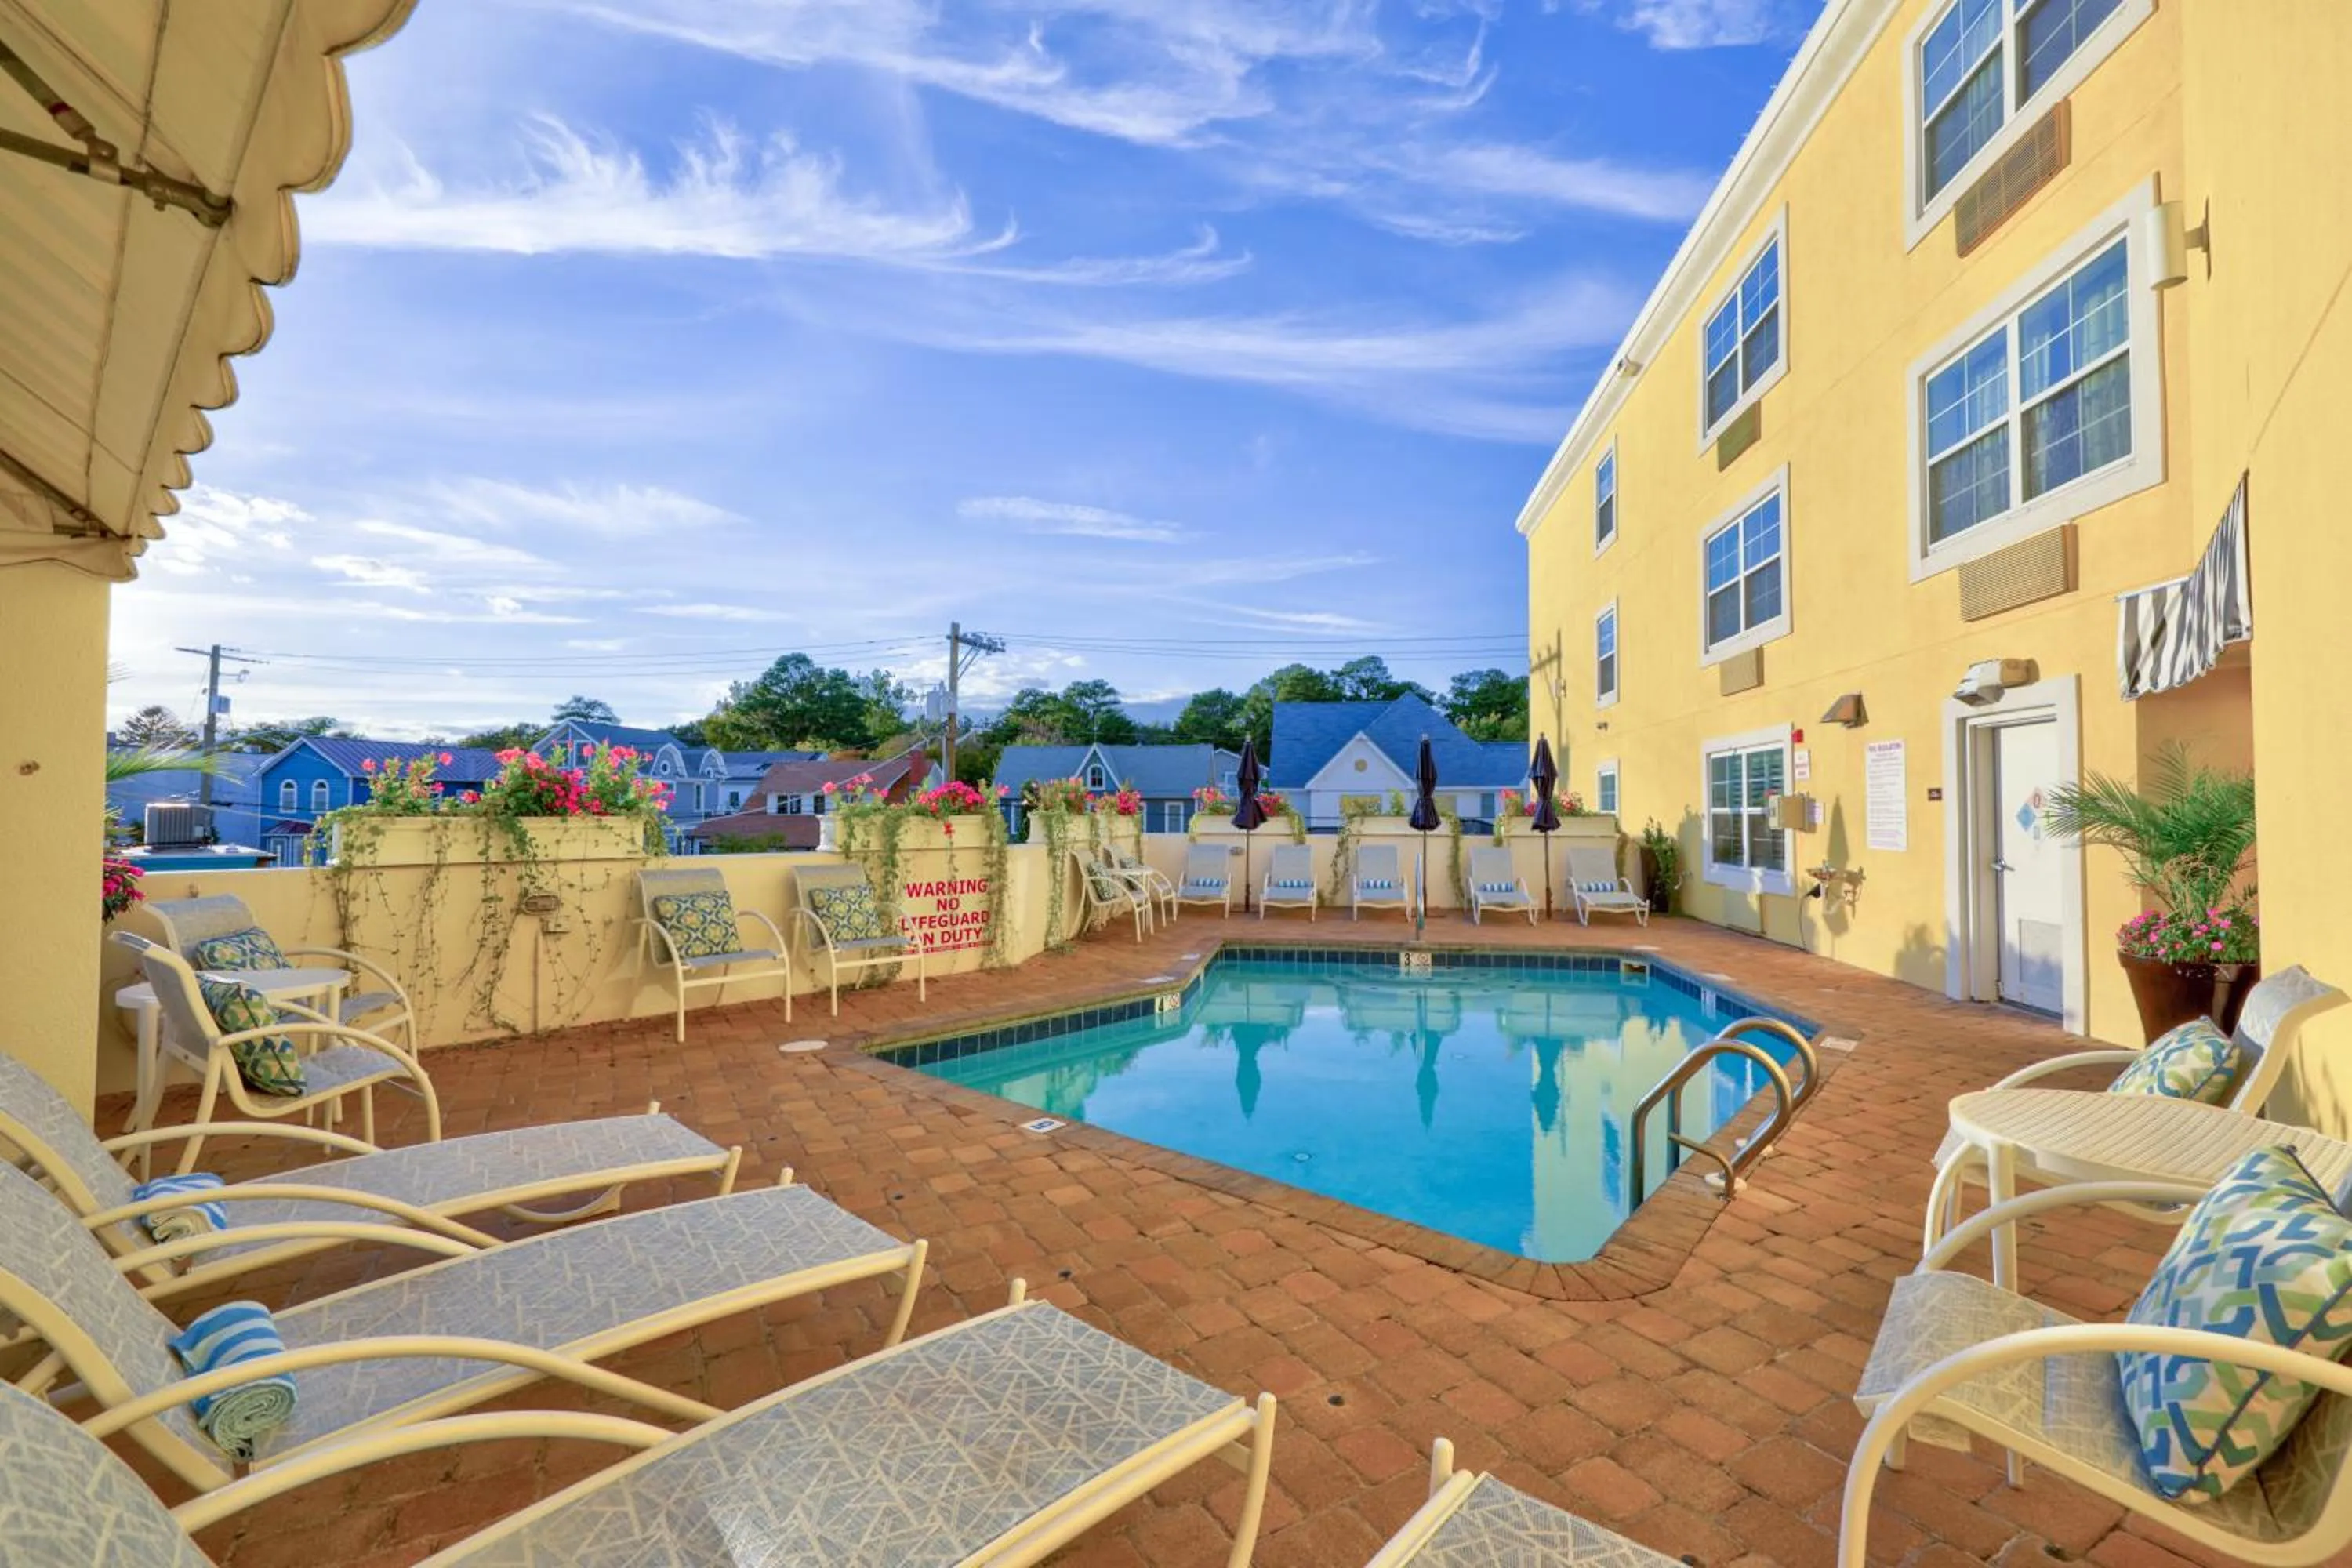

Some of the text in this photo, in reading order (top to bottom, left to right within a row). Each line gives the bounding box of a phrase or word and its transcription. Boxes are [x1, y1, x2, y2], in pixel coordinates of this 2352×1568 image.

[906, 878, 988, 898] WARNING
[937, 898, 960, 912] NO
[941, 927, 982, 944] DUTY
[1404, 953, 1410, 966] 3
